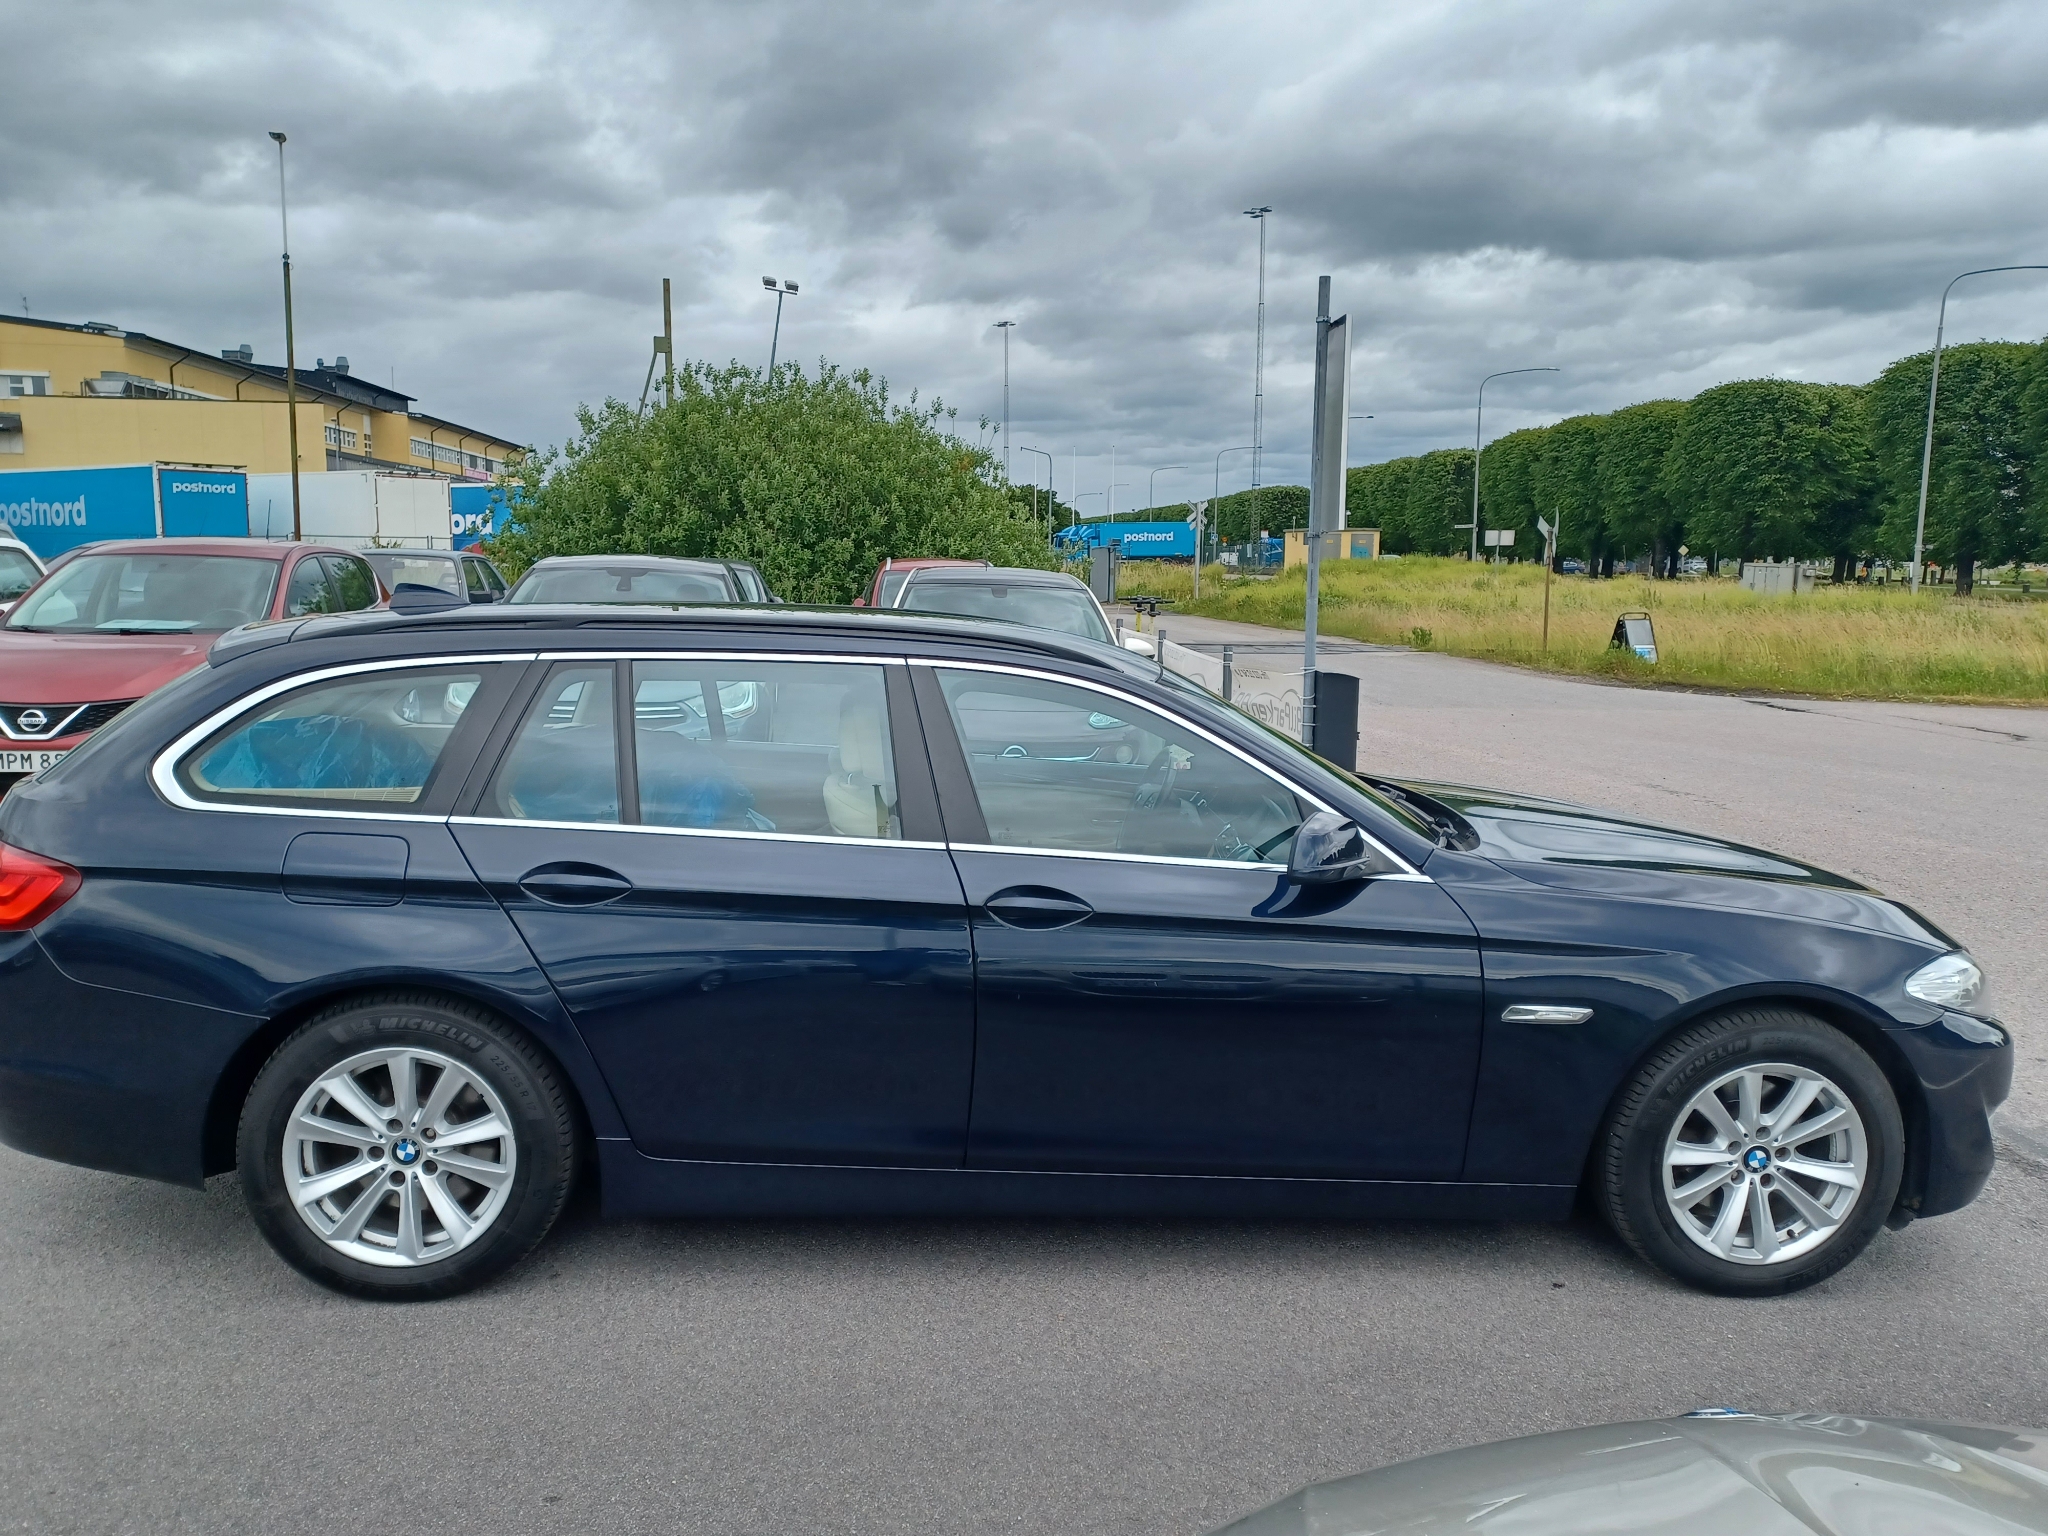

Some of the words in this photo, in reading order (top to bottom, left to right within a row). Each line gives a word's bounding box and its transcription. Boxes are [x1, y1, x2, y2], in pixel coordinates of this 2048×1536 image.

[172, 481, 236, 494] postnord
[1123, 531, 1174, 543] postnord
[40, 753, 64, 770] 8
[378, 1017, 484, 1050] MICHELIN
[490, 1055, 524, 1088] 225/55
[519, 1090, 529, 1098] R
[1666, 1037, 1748, 1096] MICHELIN
